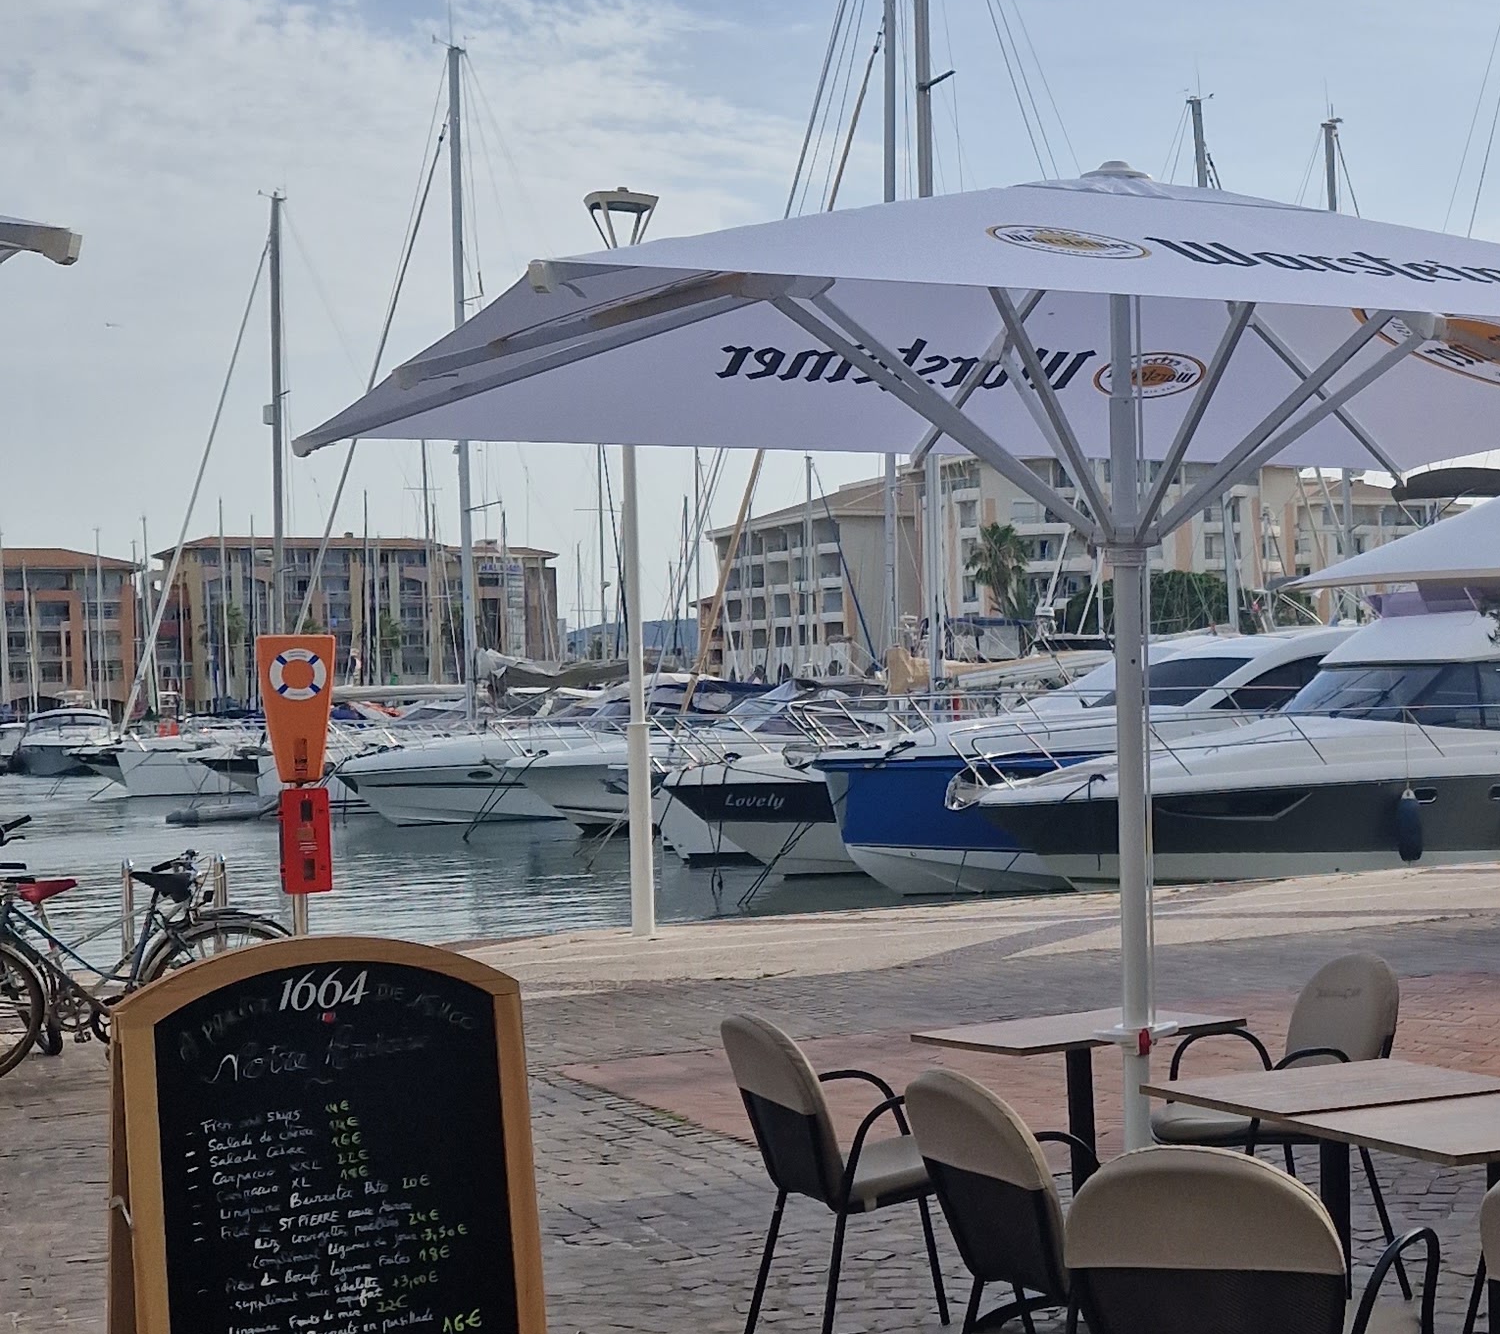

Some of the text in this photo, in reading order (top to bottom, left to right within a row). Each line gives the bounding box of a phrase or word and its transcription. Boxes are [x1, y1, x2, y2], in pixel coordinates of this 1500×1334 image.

[725, 793, 785, 810] Lovely
[278, 967, 369, 1012] 1664
[208, 1134, 253, 1152] Salade
[209, 1150, 259, 1167] Salade
[291, 1178, 312, 1188] XL
